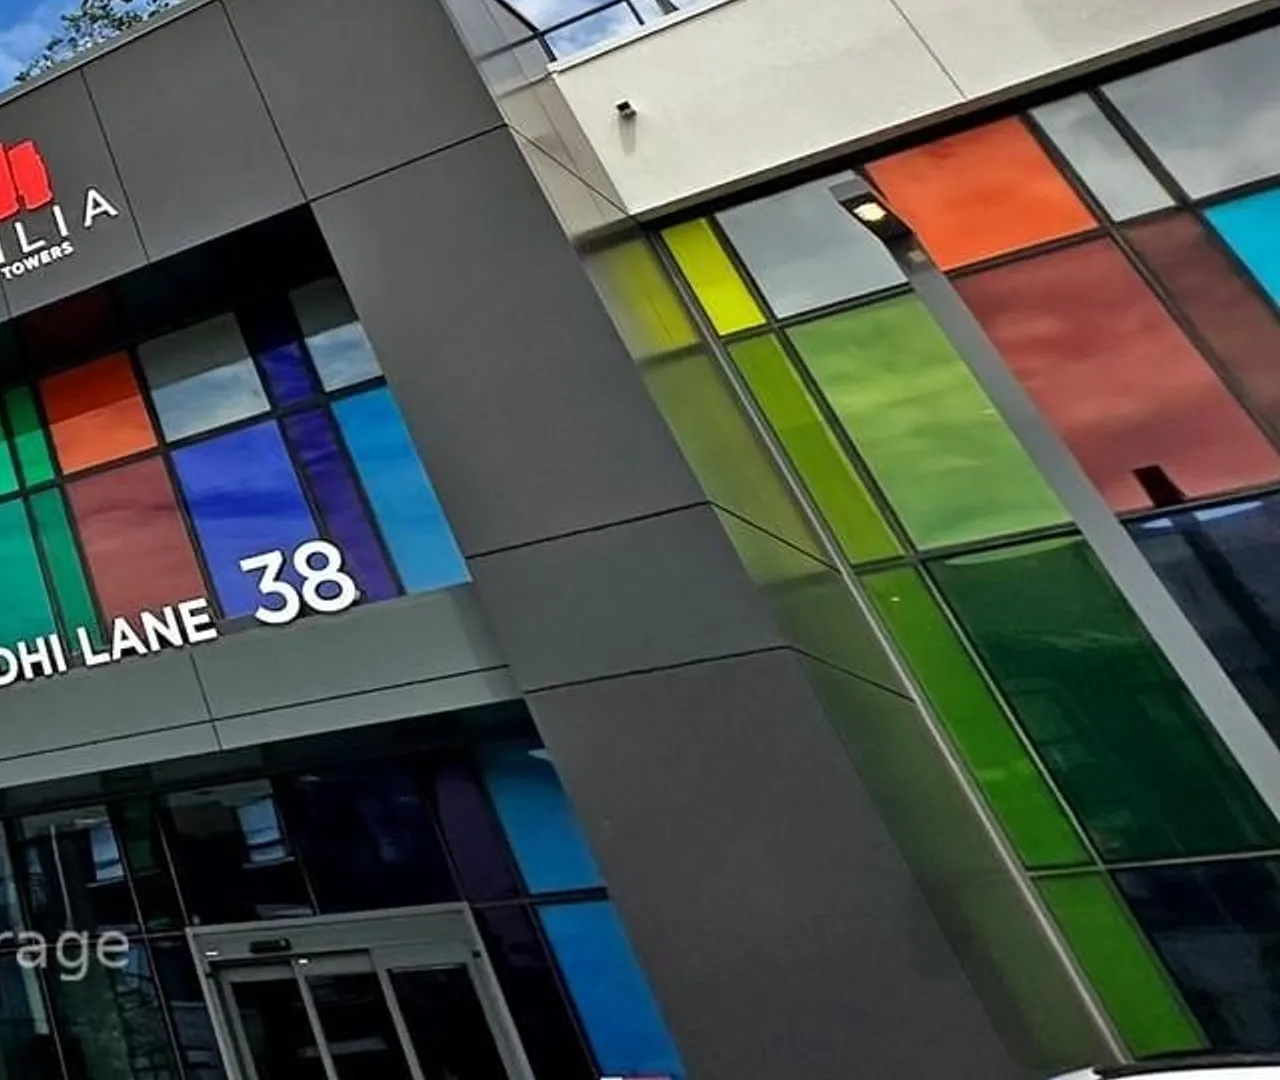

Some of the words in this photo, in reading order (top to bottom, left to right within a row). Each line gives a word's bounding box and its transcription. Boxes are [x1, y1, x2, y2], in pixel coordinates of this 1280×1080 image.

[0, 241, 74, 279] TOWERS
[76, 599, 218, 667] LANE
[239, 539, 357, 625] 38
